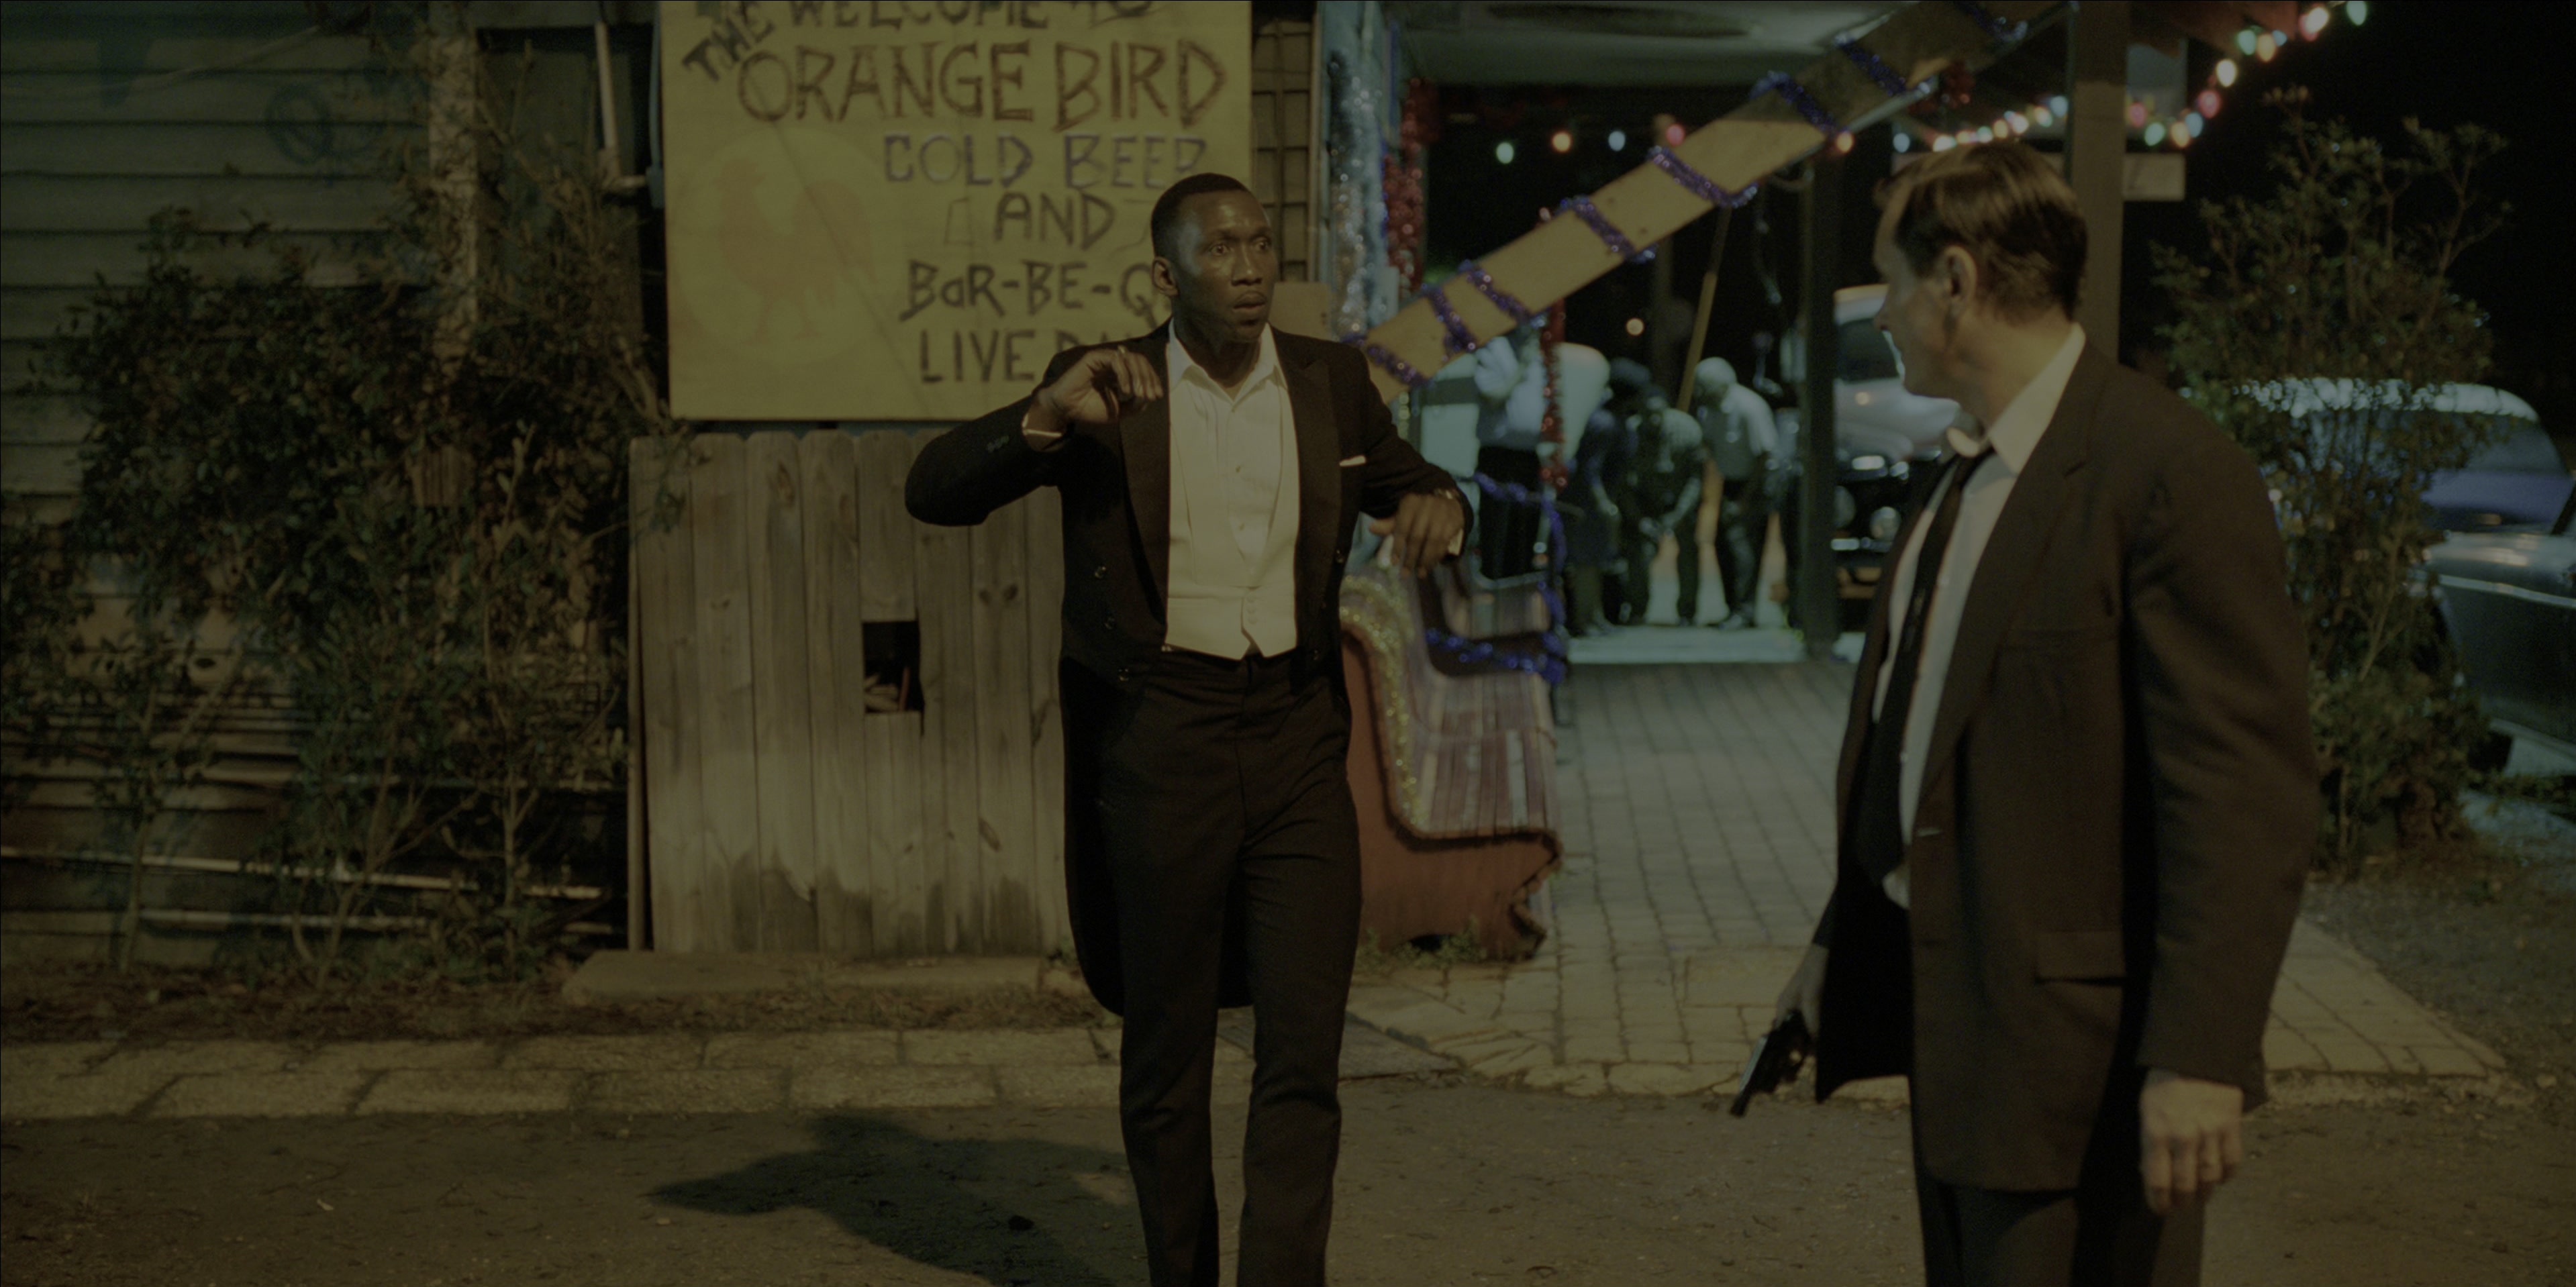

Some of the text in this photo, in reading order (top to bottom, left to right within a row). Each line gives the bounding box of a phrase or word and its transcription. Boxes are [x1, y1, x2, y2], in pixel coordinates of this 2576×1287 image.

[682, 0, 1228, 132] THE ORANGE BIRD
[884, 134, 1034, 189] COLD
[991, 191, 1117, 251] AND
[920, 328, 1036, 384] LIVE
